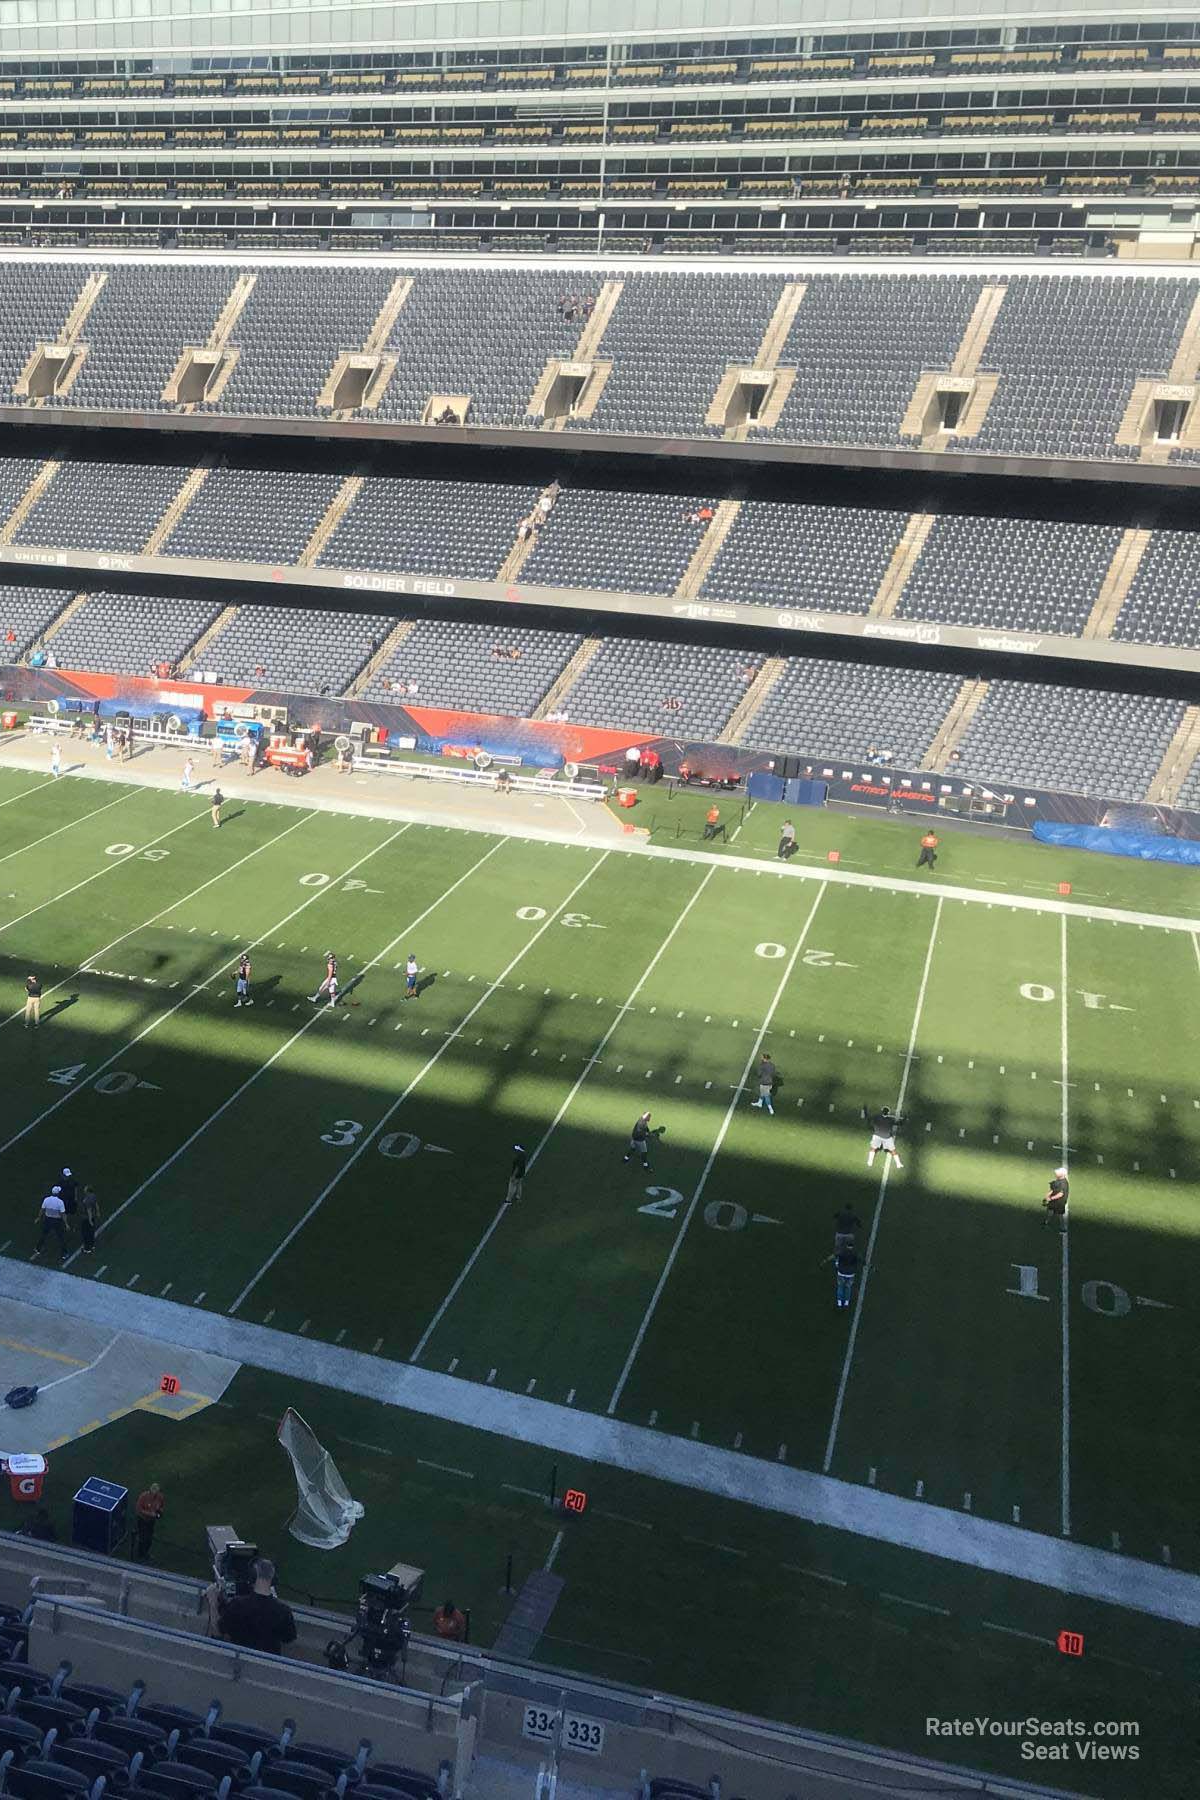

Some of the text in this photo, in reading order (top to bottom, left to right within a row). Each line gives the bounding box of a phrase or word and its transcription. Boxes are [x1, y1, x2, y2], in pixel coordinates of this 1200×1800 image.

[15, 553, 55, 562] UNITED
[110, 557, 134, 569] PNC
[343, 575, 455, 595] SOLDIER FIELD
[794, 615, 825, 630] PNC
[515, 905, 591, 929] 30
[753, 941, 836, 968] 20
[1019, 982, 1108, 1010] 10
[47, 1063, 139, 1095] 40
[319, 1119, 422, 1159] 30
[637, 1185, 748, 1231] 20
[1005, 1262, 1133, 1318] 10
[161, 1377, 177, 1393] 30
[19, 1478, 36, 1494] G
[567, 1492, 584, 1511] 20
[1064, 1634, 1081, 1653] 10
[568, 1720, 601, 1745] 333
